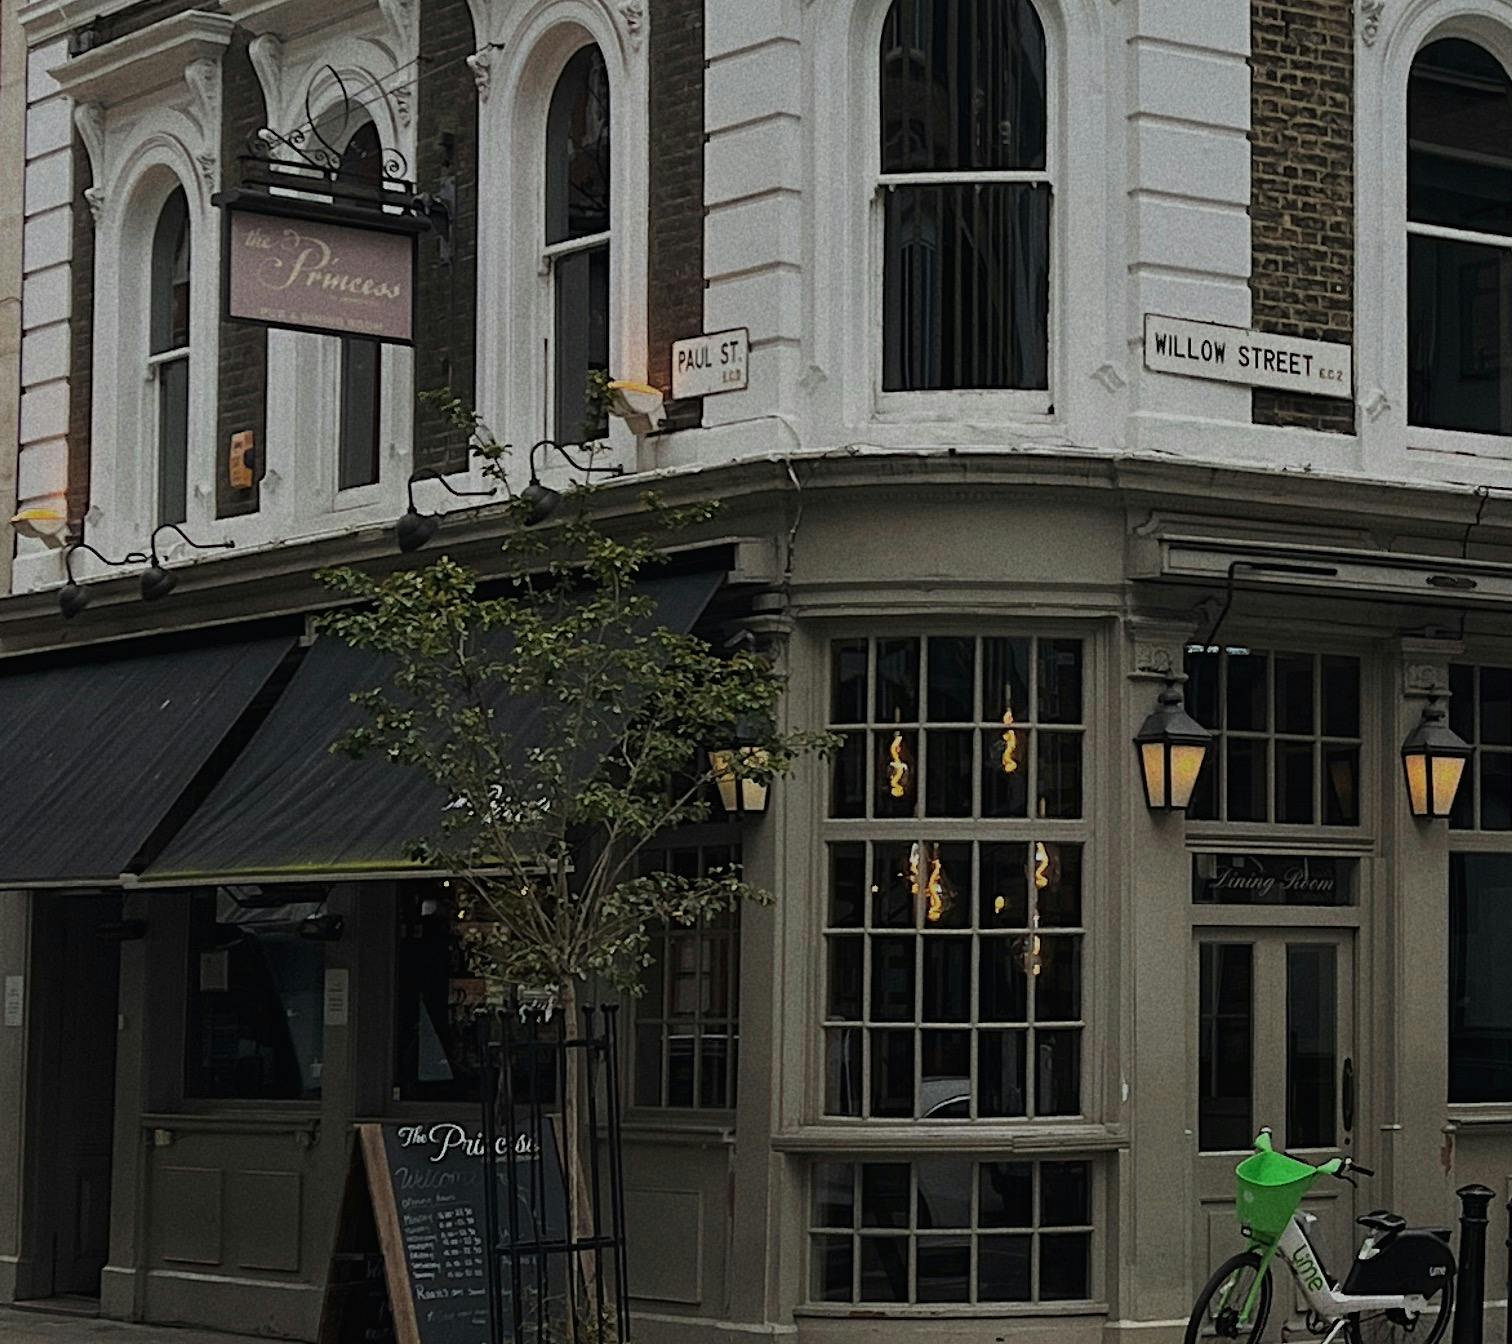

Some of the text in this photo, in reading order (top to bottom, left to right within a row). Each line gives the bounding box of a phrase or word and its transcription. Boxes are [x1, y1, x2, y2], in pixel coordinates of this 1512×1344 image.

[256, 228, 402, 300] Princess
[679, 341, 742, 373] PAUL ST.
[1155, 332, 1227, 364] WILLOW
[1238, 346, 1314, 376] STREET
[1209, 865, 1334, 897] Dining Room
[398, 1125, 428, 1148] The
[1293, 1243, 1323, 1293] Lime
